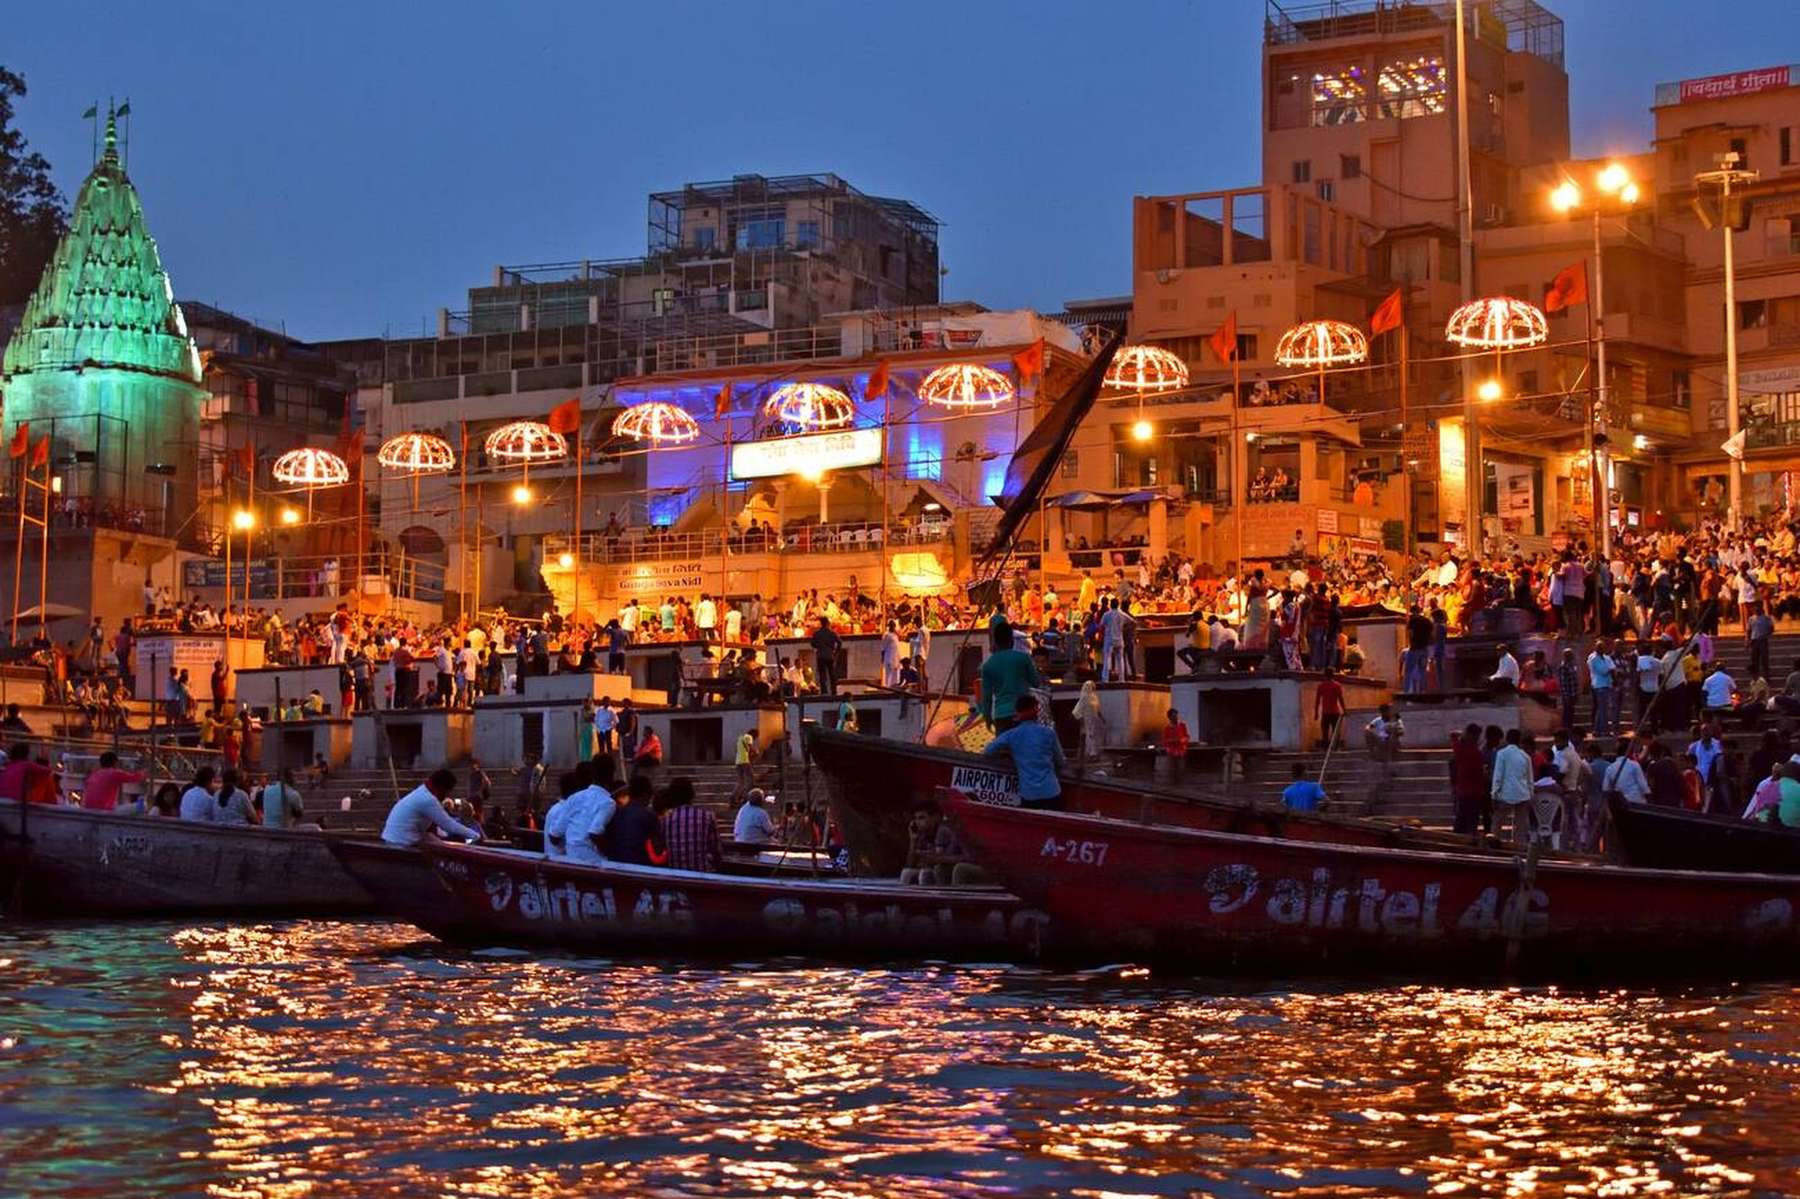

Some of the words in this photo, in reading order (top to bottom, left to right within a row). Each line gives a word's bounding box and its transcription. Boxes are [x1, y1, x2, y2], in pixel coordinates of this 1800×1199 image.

[954, 768, 1003, 791] AIRPORT
[1040, 837, 1109, 867] A-267
[517, 878, 615, 920] airtel
[1265, 866, 1441, 932] airtel
